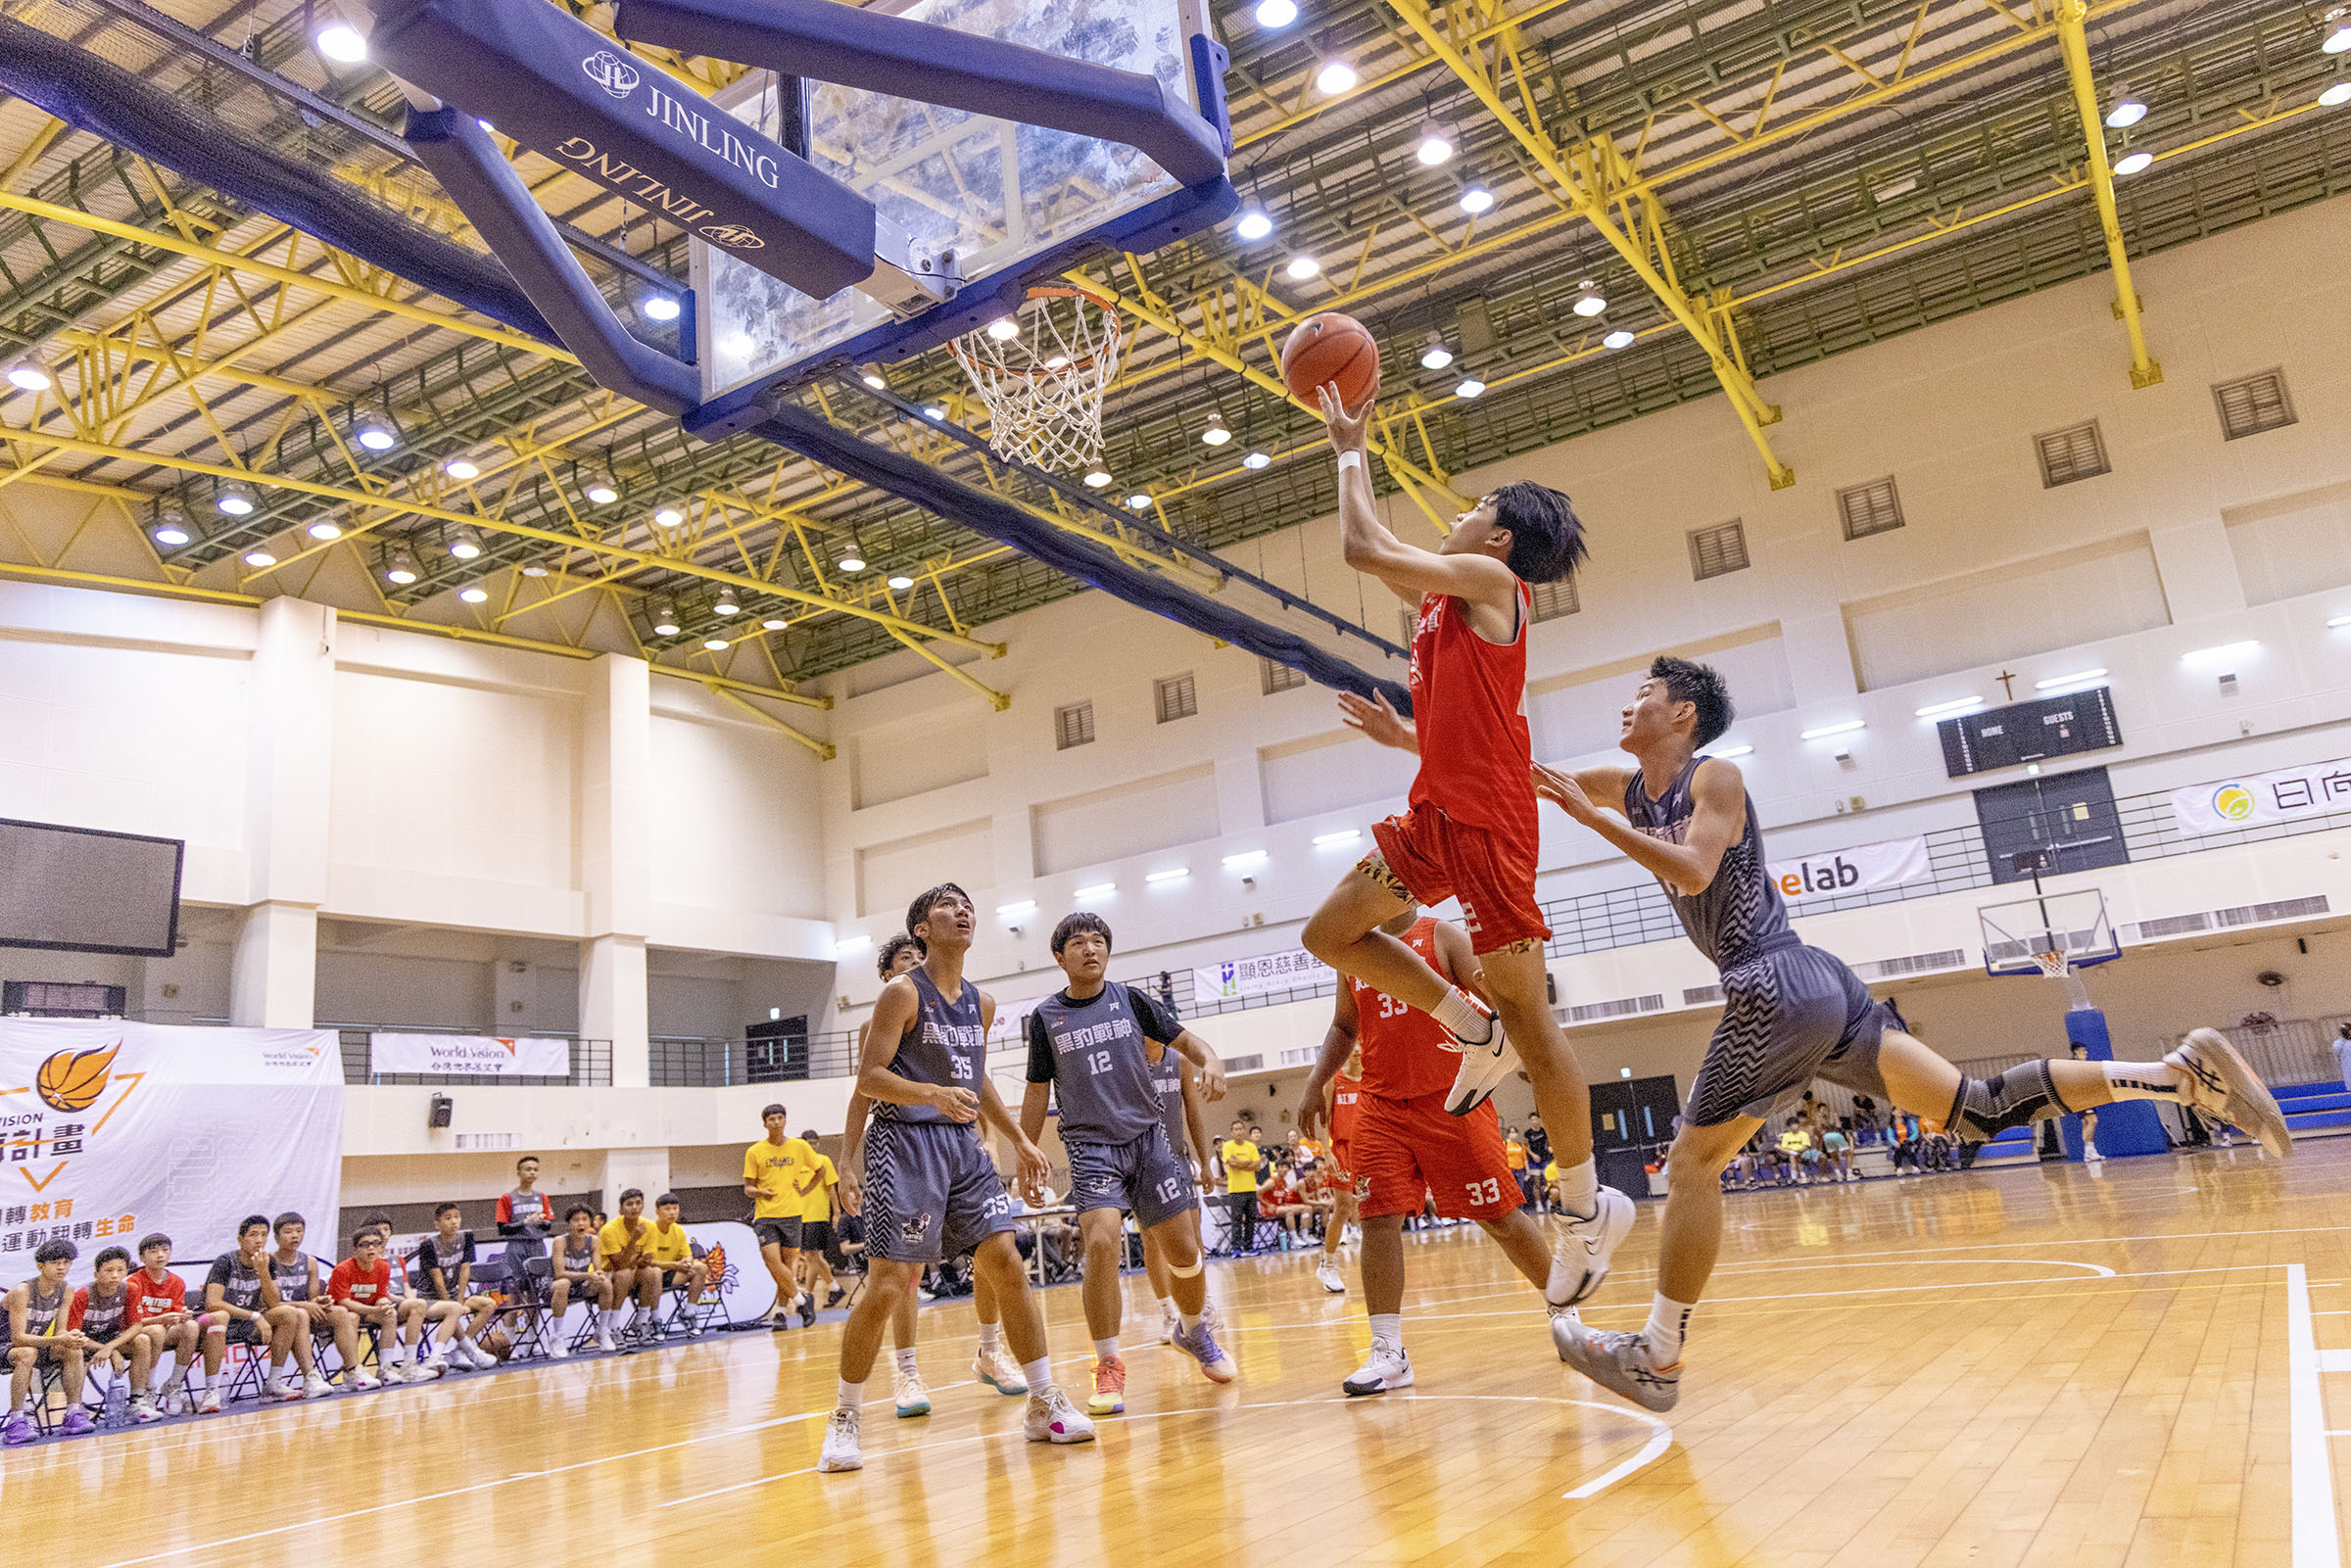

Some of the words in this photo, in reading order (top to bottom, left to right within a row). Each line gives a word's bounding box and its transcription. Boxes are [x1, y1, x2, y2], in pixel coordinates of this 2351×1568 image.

[646, 85, 780, 189] JINLING
[555, 136, 714, 224] JINLING
[1981, 725, 2004, 738] HOME
[2042, 711, 2075, 726] GUESTS
[1054, 1018, 1133, 1056] 黑豹戰神
[431, 1046, 466, 1059] World
[470, 1048, 504, 1059] Vision
[1087, 1050, 1114, 1075] 12
[950, 1055, 974, 1079] 35
[0, 1124, 85, 1163] 計畫
[1156, 1177, 1181, 1204] 12
[1465, 1177, 1501, 1206] 33
[0, 1199, 73, 1226] 轉教育
[983, 1194, 1010, 1219] 35
[2, 1214, 135, 1254] 運動翻轉生命
